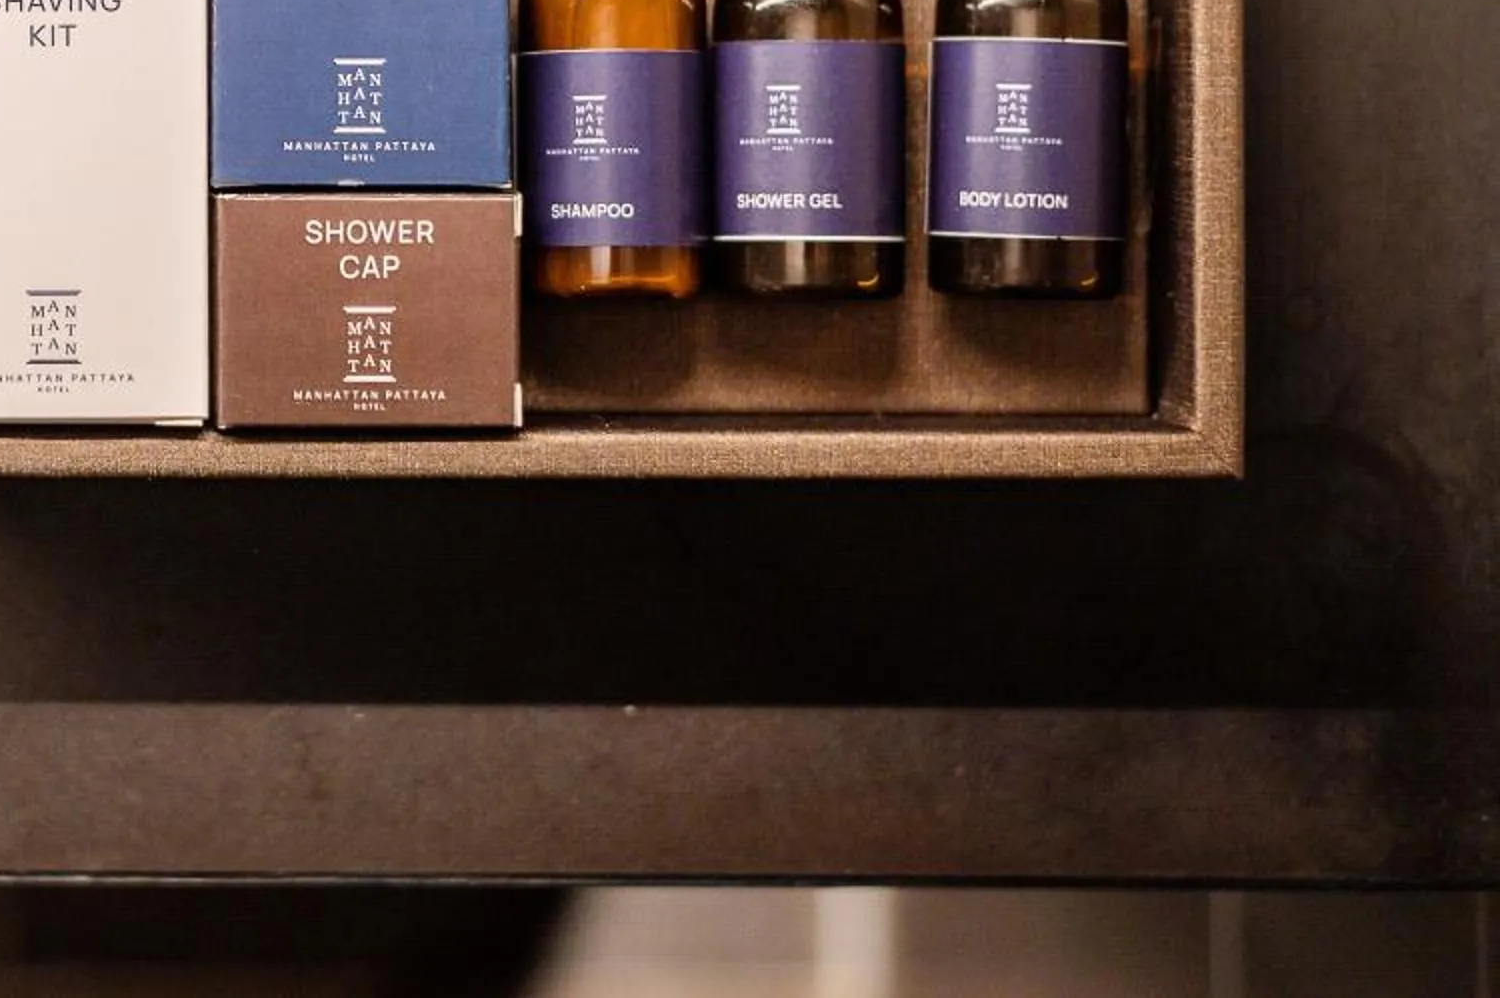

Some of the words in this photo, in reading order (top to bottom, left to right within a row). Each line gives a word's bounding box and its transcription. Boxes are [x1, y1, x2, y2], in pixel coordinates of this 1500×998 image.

[29, 24, 77, 47] KIT
[337, 67, 382, 87] MAN
[337, 87, 382, 106] HAT
[337, 105, 382, 125] TAN
[283, 141, 369, 151] MANHATTAN
[375, 141, 436, 151] PATTAYA
[736, 192, 806, 209] SHOWER
[809, 192, 844, 209] GEL
[959, 190, 1002, 207] BODY
[1004, 192, 1069, 210] LOTION
[551, 203, 635, 220] SHAMPOO
[304, 219, 435, 245] SHOWER
[339, 255, 401, 279] CAP
[31, 300, 77, 318] MAN
[31, 319, 77, 337] HAT
[347, 316, 392, 335] MAN
[31, 337, 77, 355] TAN
[347, 335, 392, 354] HAT
[347, 354, 392, 373] TAN
[71, 373, 135, 383] PATTAYA
[293, 389, 379, 400] MANHATTAN
[385, 389, 446, 400] PATTAYA
